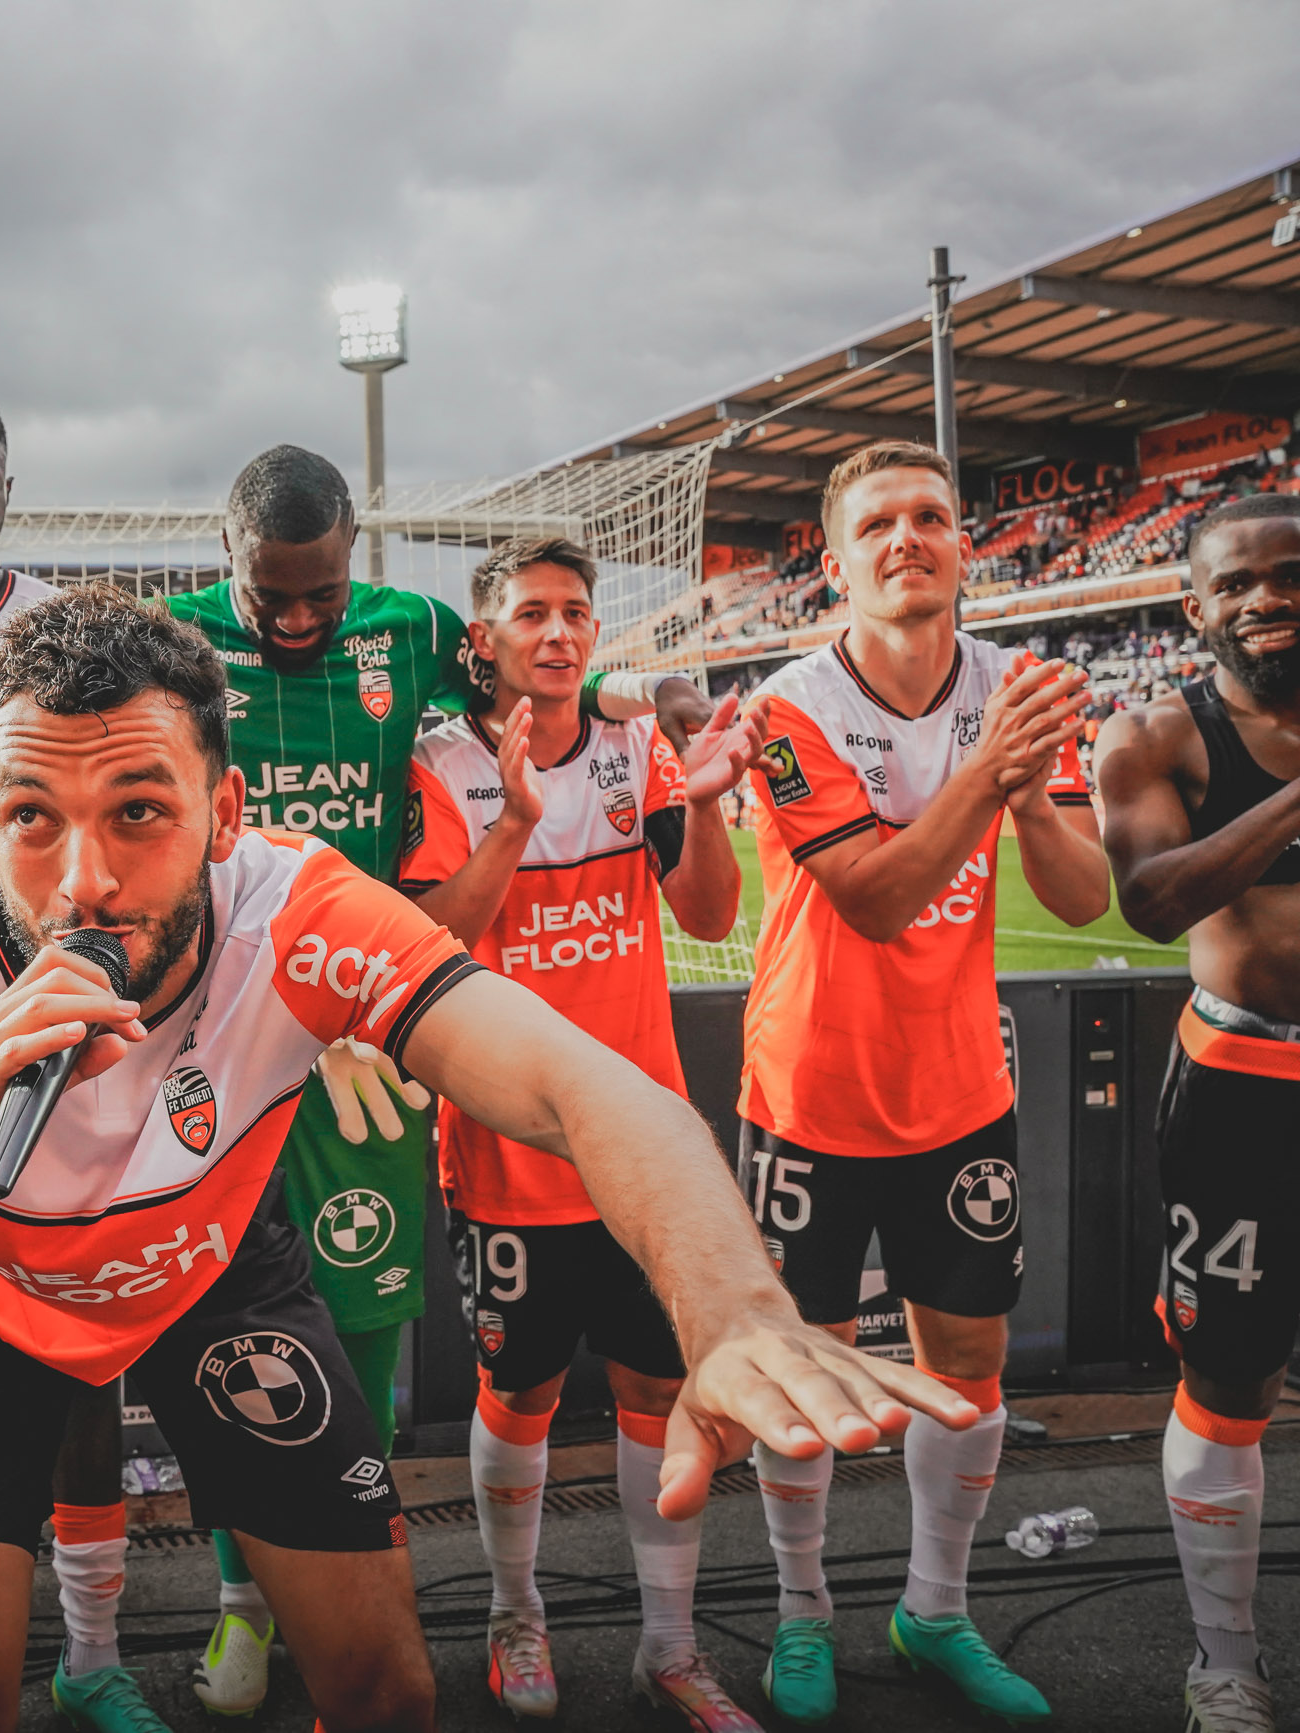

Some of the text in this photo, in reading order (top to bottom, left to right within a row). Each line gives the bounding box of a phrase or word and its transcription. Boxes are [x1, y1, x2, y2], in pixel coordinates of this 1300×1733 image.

[343, 629, 392, 657] Breizh
[357, 650, 391, 671] Cola
[248, 762, 370, 798] JEAN
[598, 770, 631, 789] Cola
[774, 780, 798, 794] LIGUE
[791, 786, 809, 798] Eats
[519, 892, 625, 937] JEAN
[501, 920, 644, 975] FLOC'H
[168, 1087, 213, 1114] FC LORIENT
[959, 1163, 1012, 1189] BMW
[752, 1150, 813, 1232] 15
[325, 1193, 384, 1220] BMW
[1170, 1203, 1264, 1292] 24
[468, 1223, 528, 1303] 19
[377, 1282, 407, 1296] umbro
[205, 1338, 296, 1377] BMW
